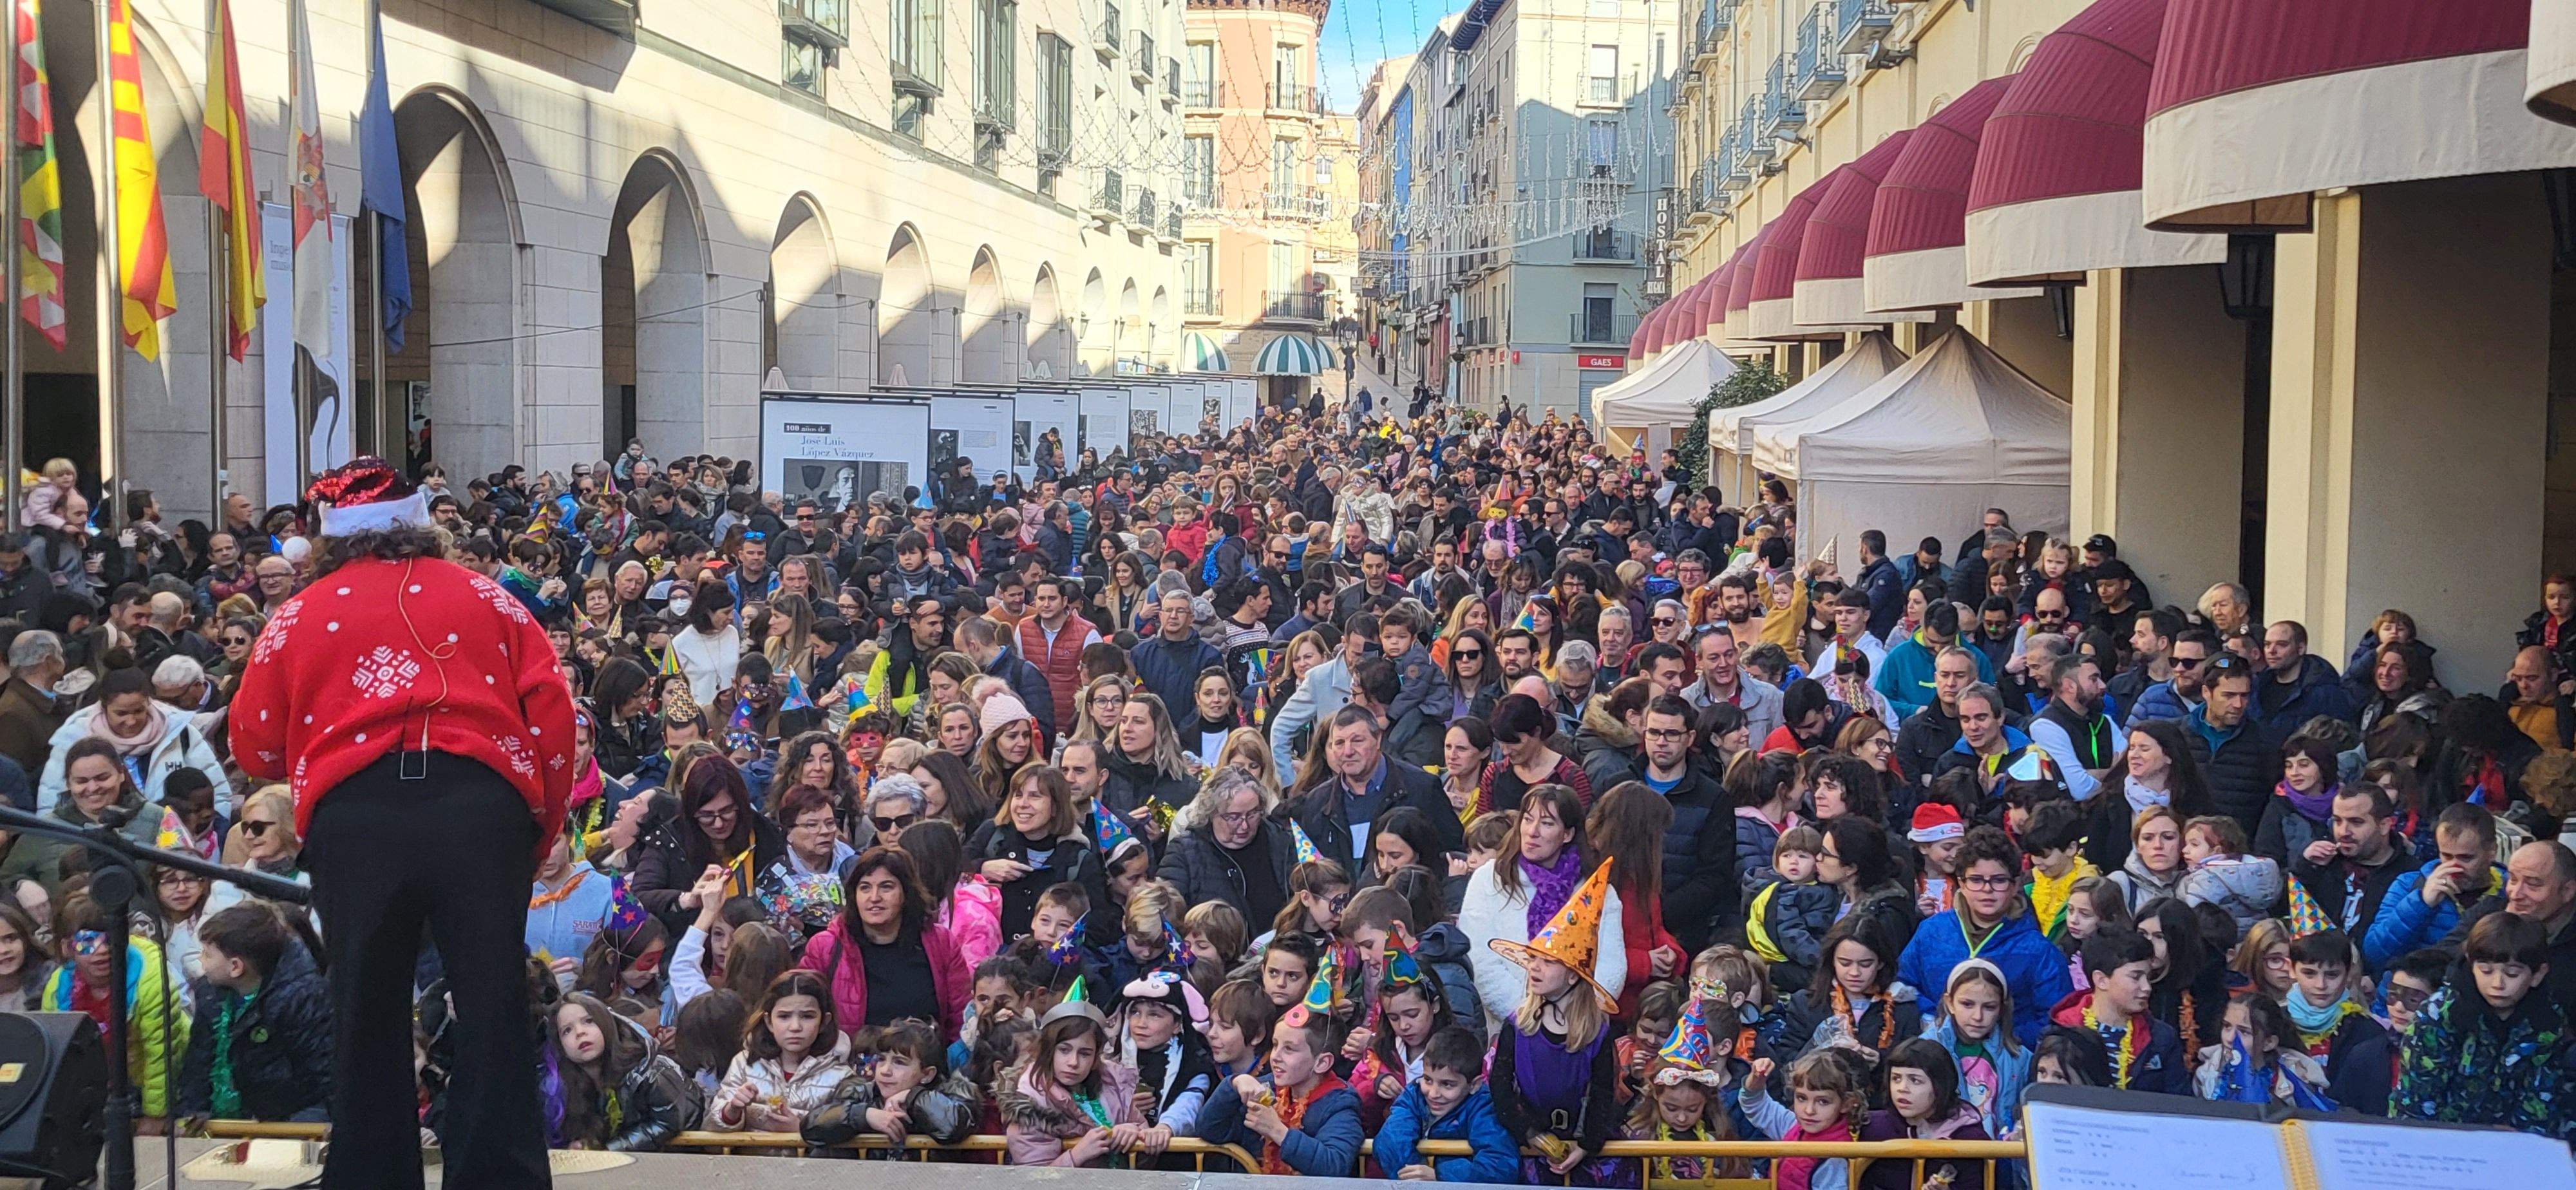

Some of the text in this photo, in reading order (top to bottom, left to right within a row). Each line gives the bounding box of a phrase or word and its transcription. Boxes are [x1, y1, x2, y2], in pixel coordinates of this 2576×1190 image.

[1654, 198, 1668, 278] HOSTAL
[1590, 358, 1612, 366] GAES
[801, 436, 845, 446] José Luis
[802, 447, 875, 460] López Vázquez
